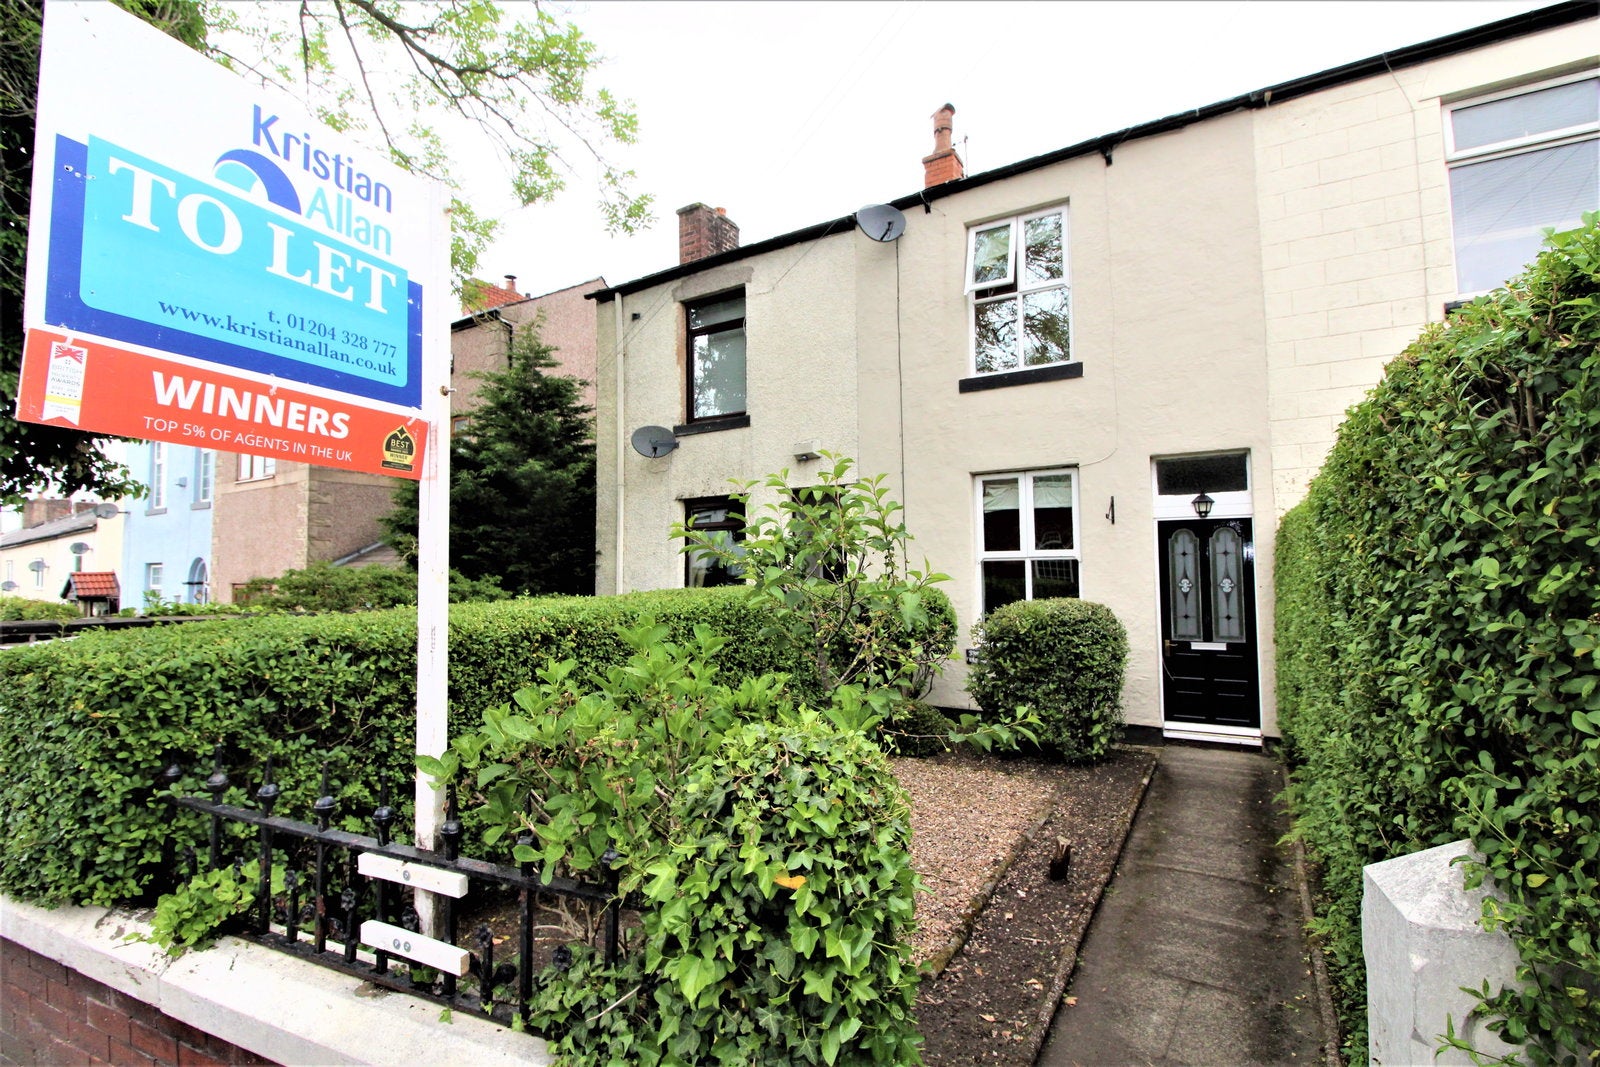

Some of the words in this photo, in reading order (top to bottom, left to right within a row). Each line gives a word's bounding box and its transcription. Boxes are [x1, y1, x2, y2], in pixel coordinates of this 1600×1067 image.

[253, 104, 392, 213] Kristian
[109, 156, 243, 255] TO
[266, 222, 396, 314] LET
[305, 186, 391, 256] Allan
[158, 300, 397, 376] www.kristianallan.co.uk
[287, 313, 336, 340] 01204
[341, 330, 368, 350] 328
[372, 339, 397, 358] 777
[143, 416, 178, 433] TOP
[182, 424, 205, 438] 5%
[210, 428, 232, 442] OF
[234, 432, 290, 451] AGENTS
[293, 442, 307, 455] IN
[310, 445, 333, 459] THE
[336, 449, 353, 462] UK
[152, 371, 350, 439] WINNERS
[391, 439, 409, 448] BEST
